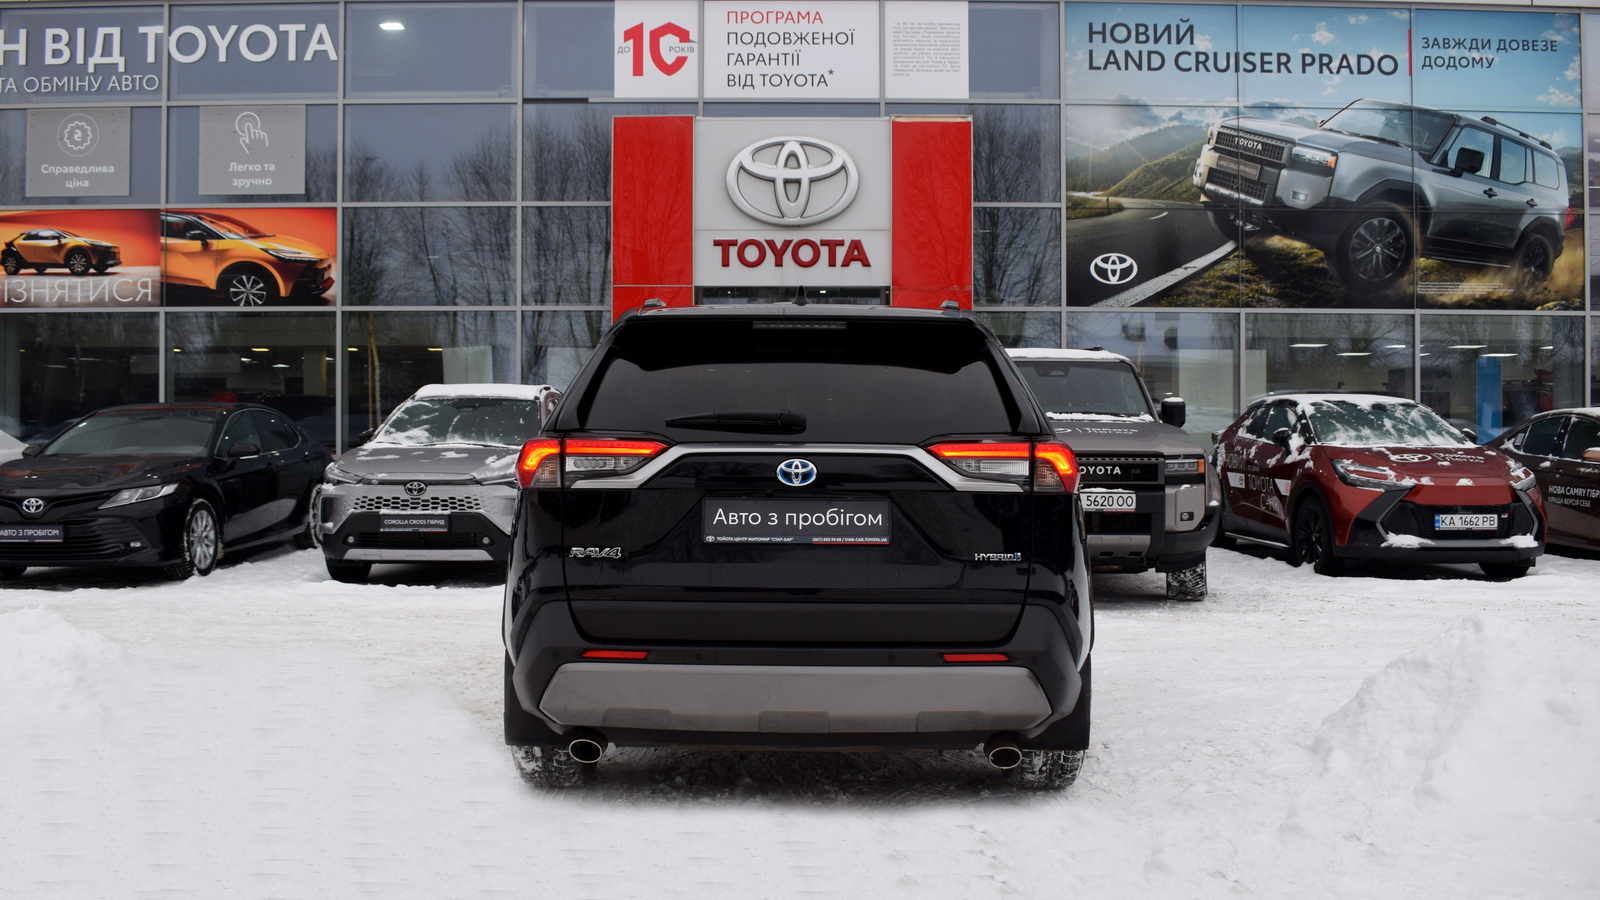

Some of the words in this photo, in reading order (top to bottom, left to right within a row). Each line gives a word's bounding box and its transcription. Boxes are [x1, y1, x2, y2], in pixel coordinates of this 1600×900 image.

[726, 10, 824, 24] ПРОГРАМА
[726, 29, 855, 48] ПОДОВЖЕНОЇ
[1088, 18, 1195, 45] НОВИЙ
[44, 27, 126, 73] ВІД
[138, 23, 339, 64] TOYOTA
[617, 45, 631, 54] ДО
[668, 45, 695, 53] РОКІВ
[1421, 37, 1491, 52] ЗАВЖДИ
[1496, 39, 1558, 53] ДОВЕЗЕ
[726, 50, 802, 66] ГАРАНТІЇ
[1088, 49, 1166, 71] LAND
[1174, 50, 1293, 73] CRUISER
[1301, 53, 1399, 76] PRADO
[1421, 56, 1495, 70] ДОДОМУ
[23, 76, 103, 93] ОБМІНУ
[107, 74, 160, 92] АВТО
[726, 74, 756, 89] ВІД
[1235, 137, 1262, 150] TOYOTA
[40, 163, 115, 175] Справедлива
[228, 162, 261, 173] Легко
[262, 164, 276, 172] та
[65, 178, 90, 189] ціна
[231, 177, 273, 187] зручно
[713, 238, 872, 268] TOYOTA
[3, 278, 152, 303] ІЗНЯТИСЯ
[1080, 466, 1121, 475] OYOTA
[1247, 474, 1275, 494] TOYOTA
[1548, 485, 1565, 494] НОВА
[1565, 487, 1587, 497] CAMRY
[1587, 489, 1600, 499] ГІБР
[1086, 495, 1115, 507] 5620
[1116, 495, 1134, 507] OO
[712, 507, 762, 525] Авто
[767, 512, 779, 526] з
[785, 507, 883, 530] пробігом
[1440, 516, 1456, 526] KA
[1459, 516, 1480, 526] 1662
[1481, 516, 1496, 526] PB
[0, 529, 18, 537] АВТО
[18, 529, 23, 537] З
[24, 529, 60, 537] ПРОБІГОМ
[569, 547, 621, 558] RAV4
[974, 552, 1015, 561] HYBRID
